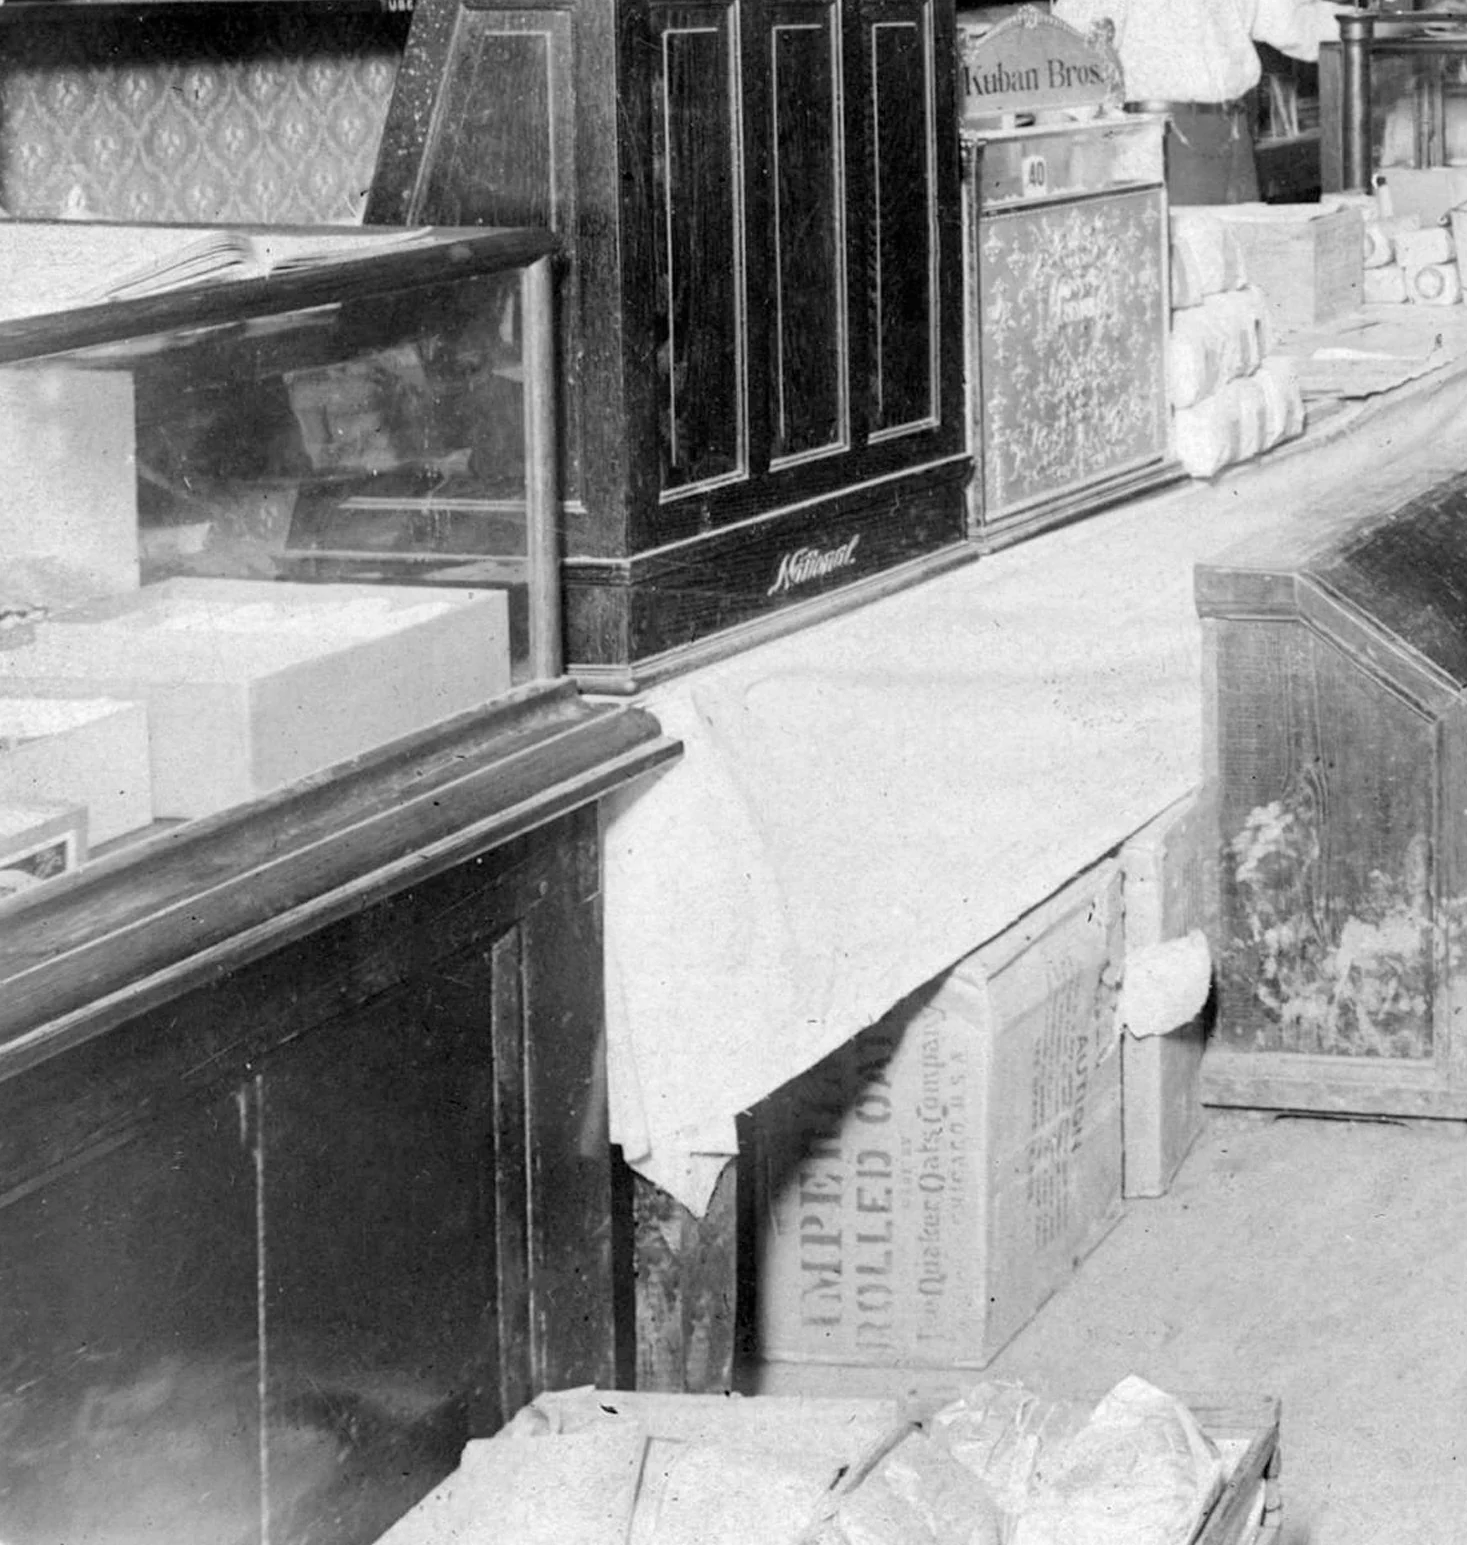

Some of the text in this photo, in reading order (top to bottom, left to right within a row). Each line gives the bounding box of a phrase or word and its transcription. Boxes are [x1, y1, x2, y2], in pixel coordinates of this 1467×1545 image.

[1028, 162, 1044, 186] 40
[916, 1007, 949, 1123] Company
[1070, 1034, 1089, 1154] AUTION
[854, 1032, 894, 1351] ROLLED OAT
[916, 1125, 946, 1195] Oats
[916, 1200, 947, 1297] Quaker
